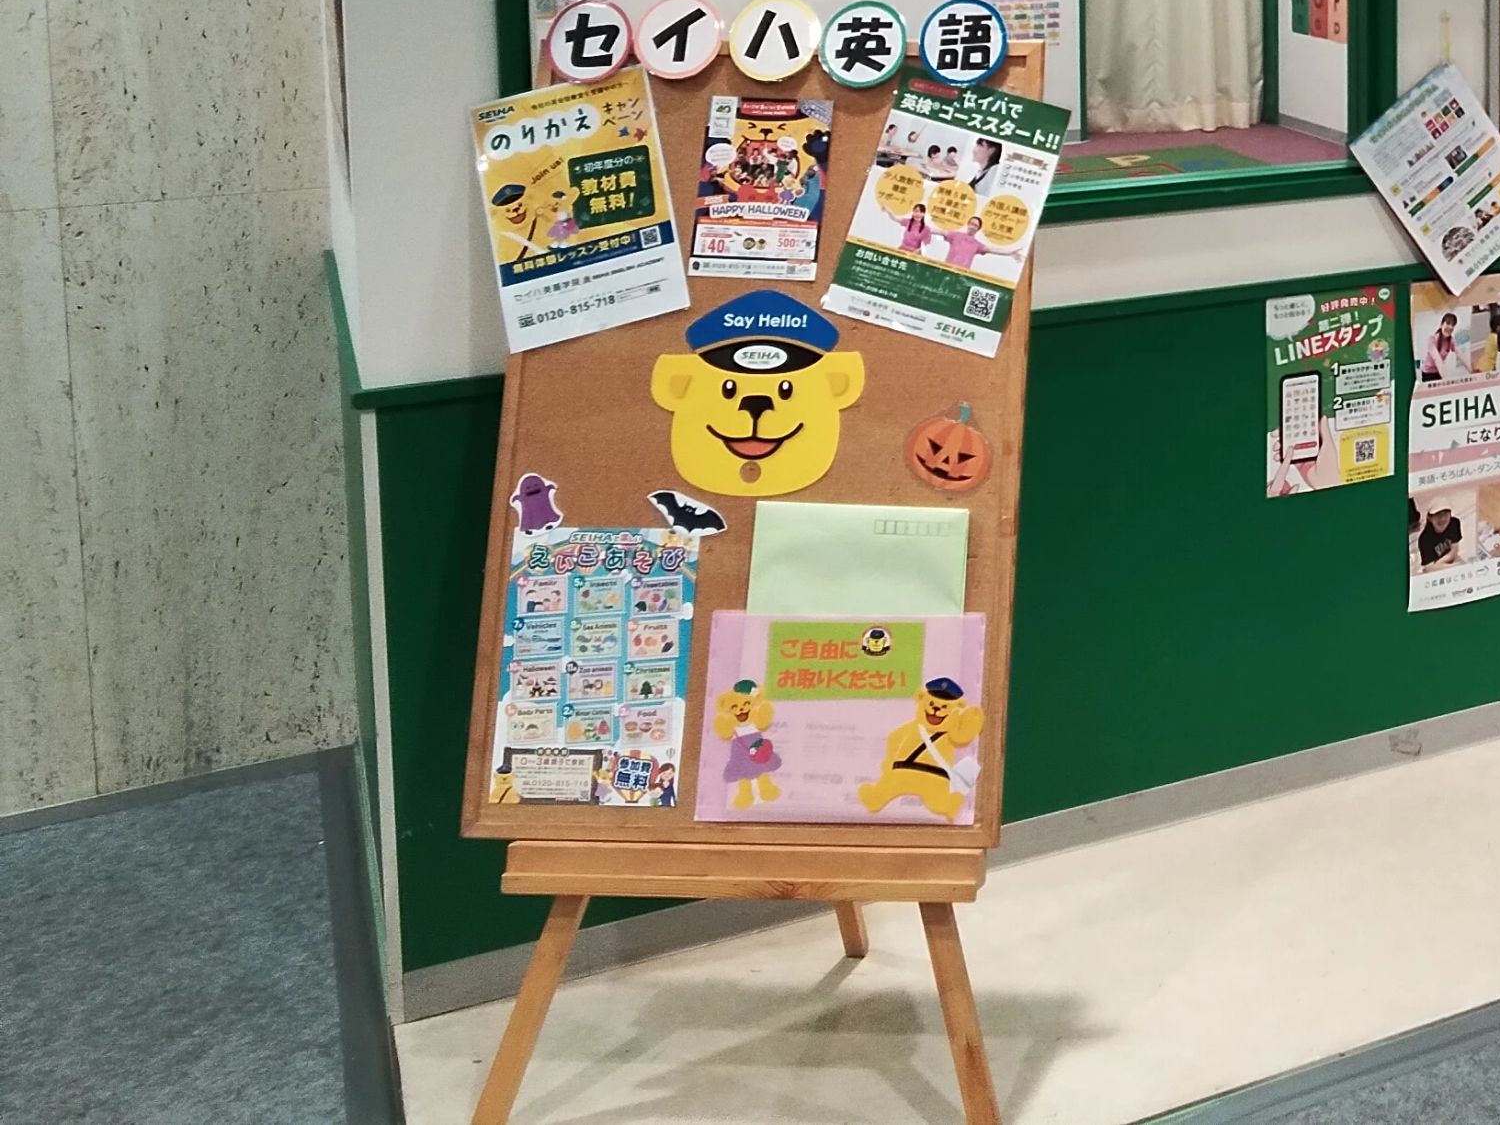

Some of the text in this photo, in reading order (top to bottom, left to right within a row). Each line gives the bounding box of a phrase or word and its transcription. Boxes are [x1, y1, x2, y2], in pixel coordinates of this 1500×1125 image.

[564, 7, 993, 73] セイハ英語
[961, 90, 1024, 119] セイハで
[491, 108, 592, 152] のりかえ
[583, 154, 635, 174] 初年度分の
[580, 171, 637, 197] 教材費
[712, 204, 808, 219] HAPPY HALLOWEEN
[536, 294, 617, 324] 0120-815-718
[723, 313, 809, 329] Say Hello!
[933, 321, 976, 341] SEIHA
[1273, 314, 1385, 366] LINEスタンプ
[740, 350, 781, 361] SEIHA
[780, 638, 860, 661] ご自由に
[777, 668, 907, 692] お取りください
[636, 709, 658, 718] Food
[619, 757, 653, 773] 参加費
[615, 771, 649, 791] 無料
